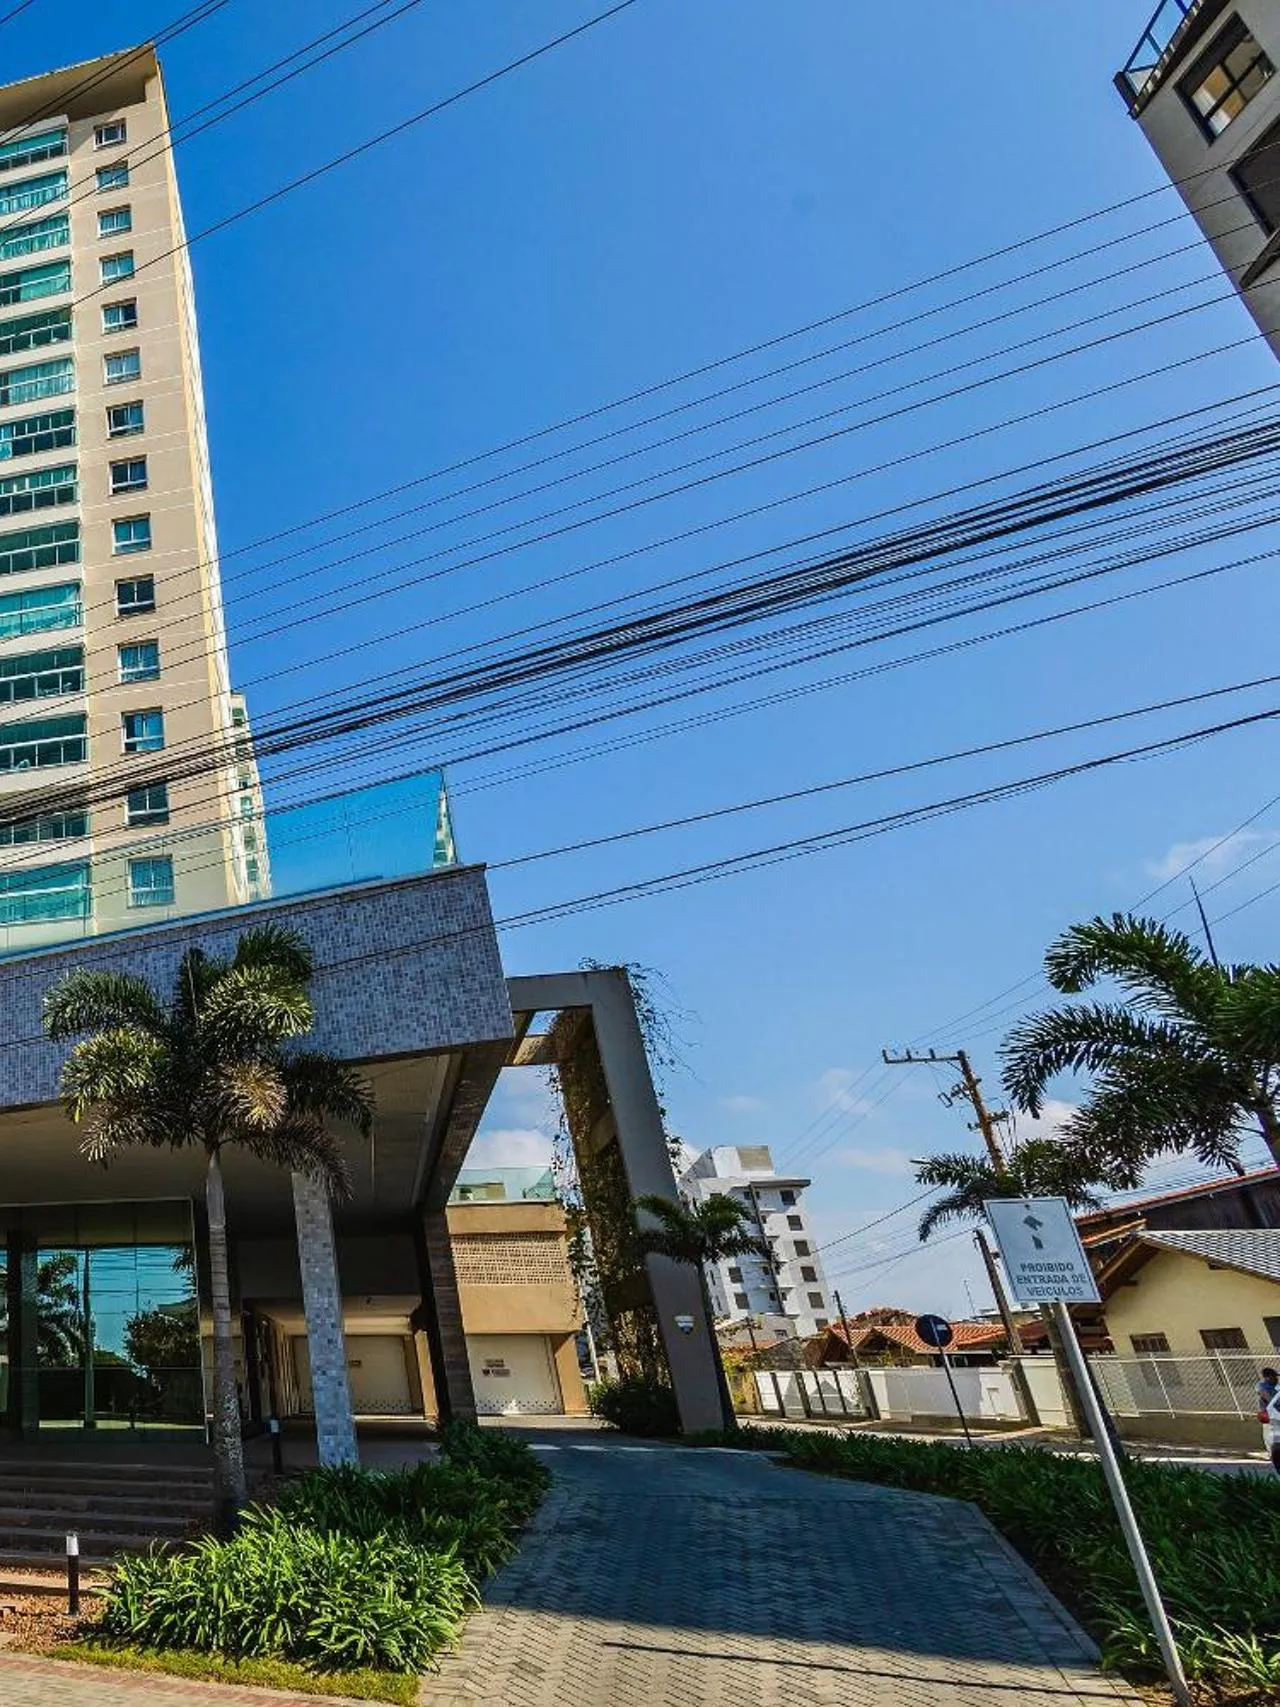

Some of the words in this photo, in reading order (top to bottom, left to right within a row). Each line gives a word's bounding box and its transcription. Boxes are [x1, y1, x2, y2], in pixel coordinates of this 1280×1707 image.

[1020, 1262, 1074, 1273] PROIBIDO
[1016, 1274, 1069, 1285] ENTRADA
[1071, 1273, 1087, 1284] DE
